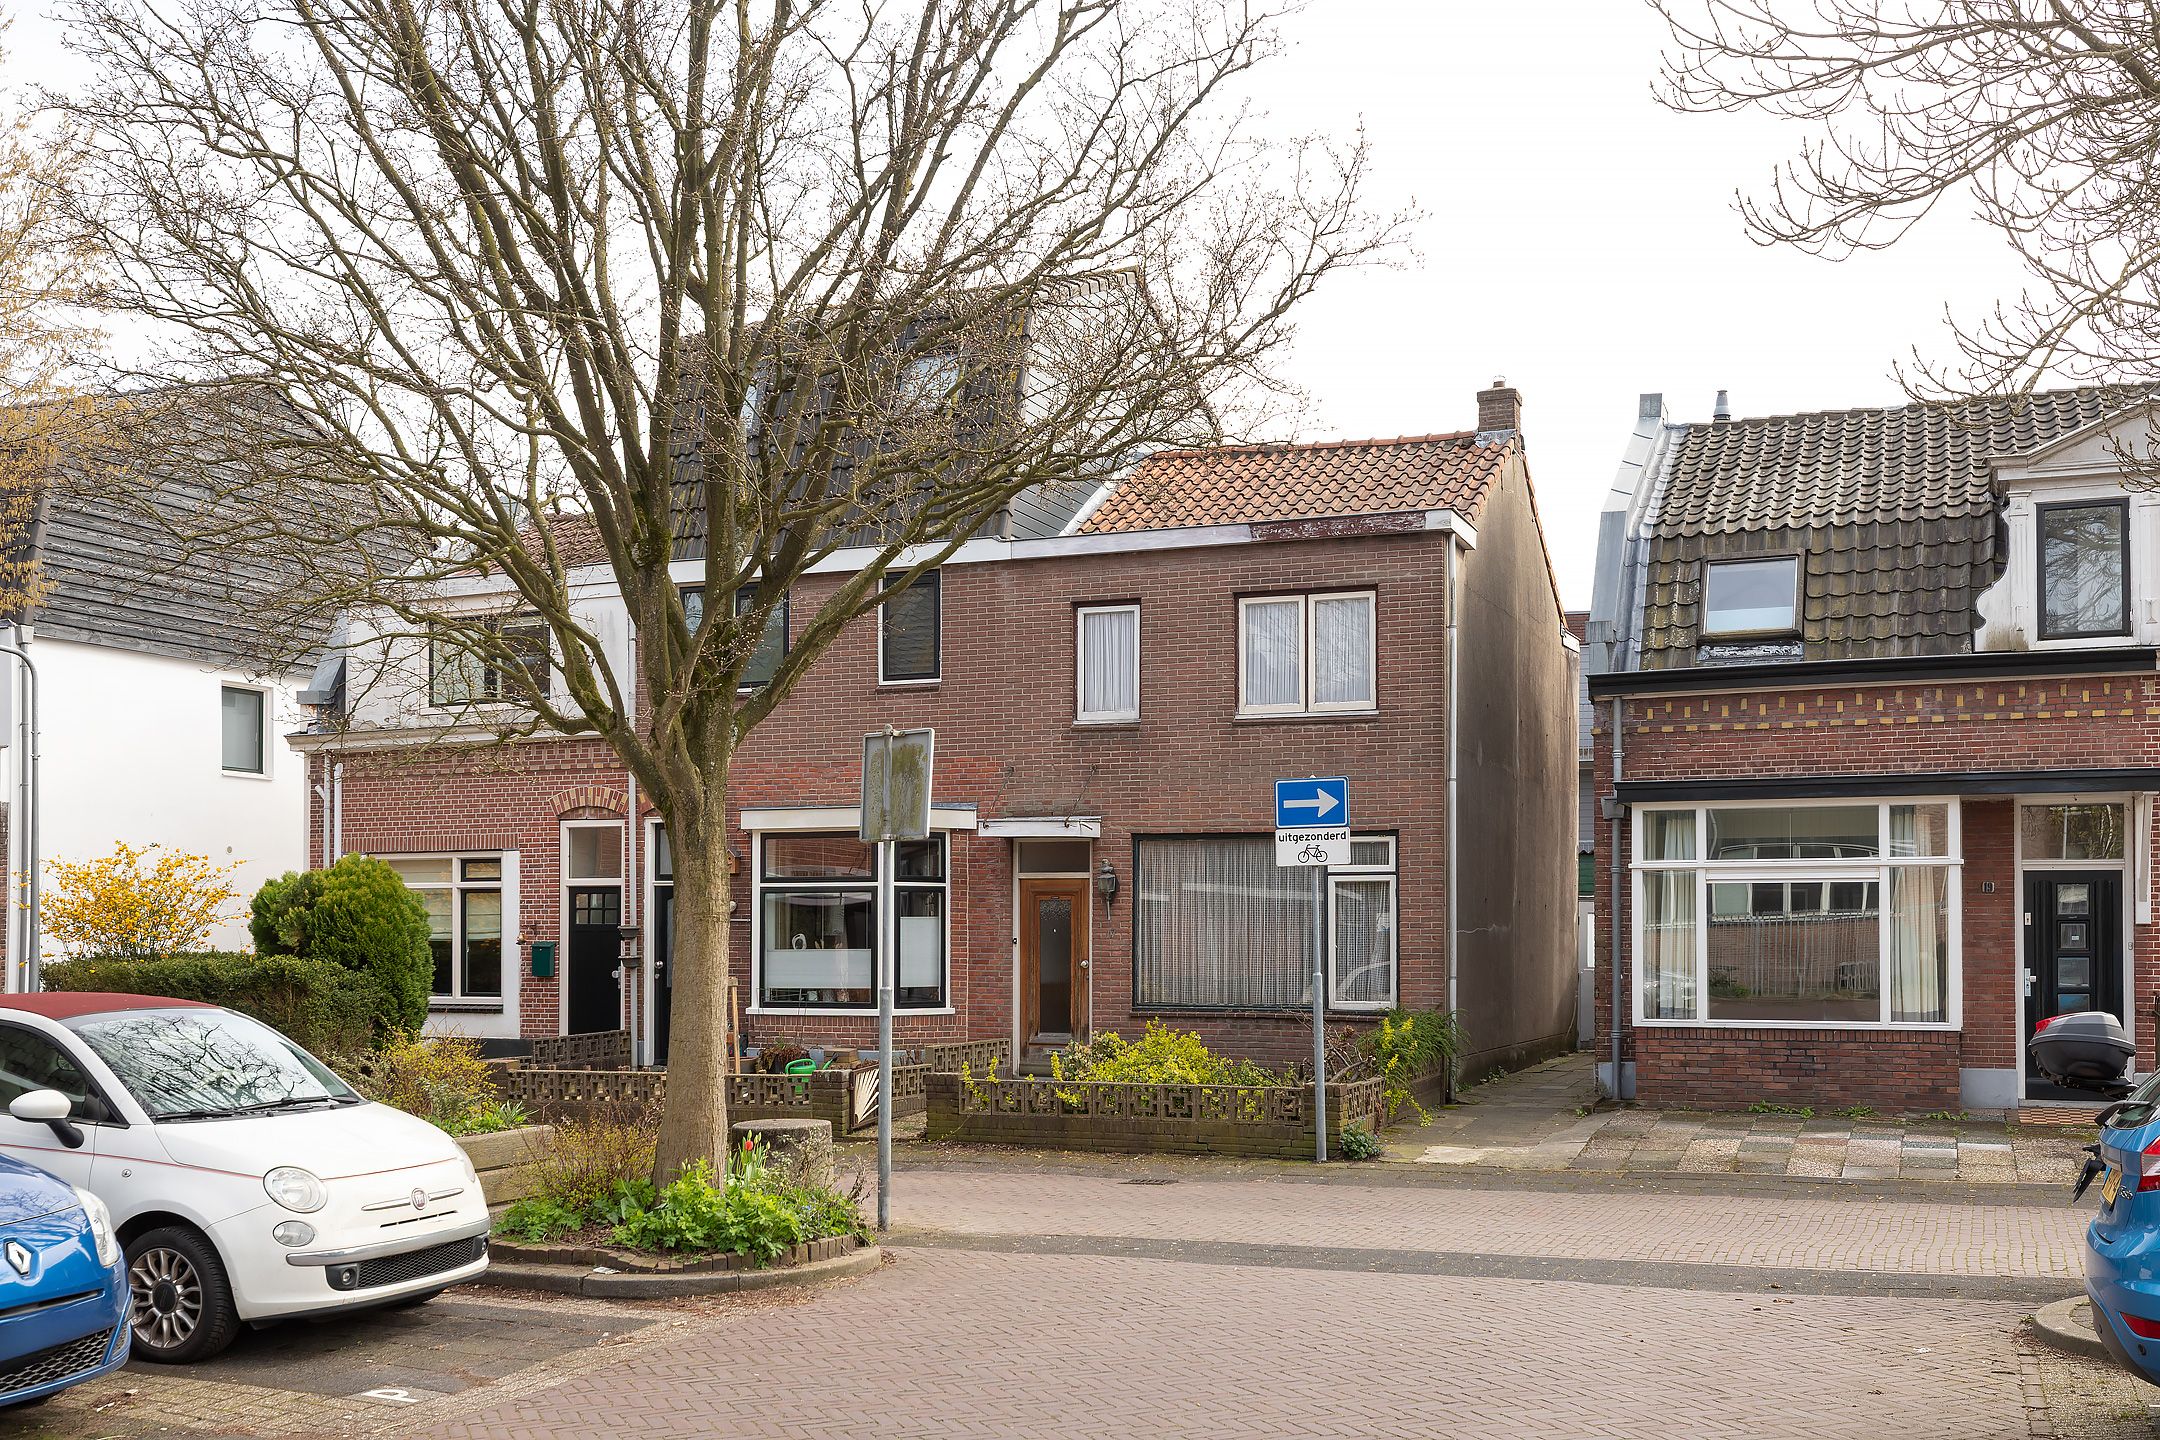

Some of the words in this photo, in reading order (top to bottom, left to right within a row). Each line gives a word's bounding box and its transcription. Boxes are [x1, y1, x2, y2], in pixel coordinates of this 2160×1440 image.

[1278, 831, 1346, 845] uitgezonderd
[1983, 882, 1994, 893] 19
[360, 1389, 420, 1403] P
